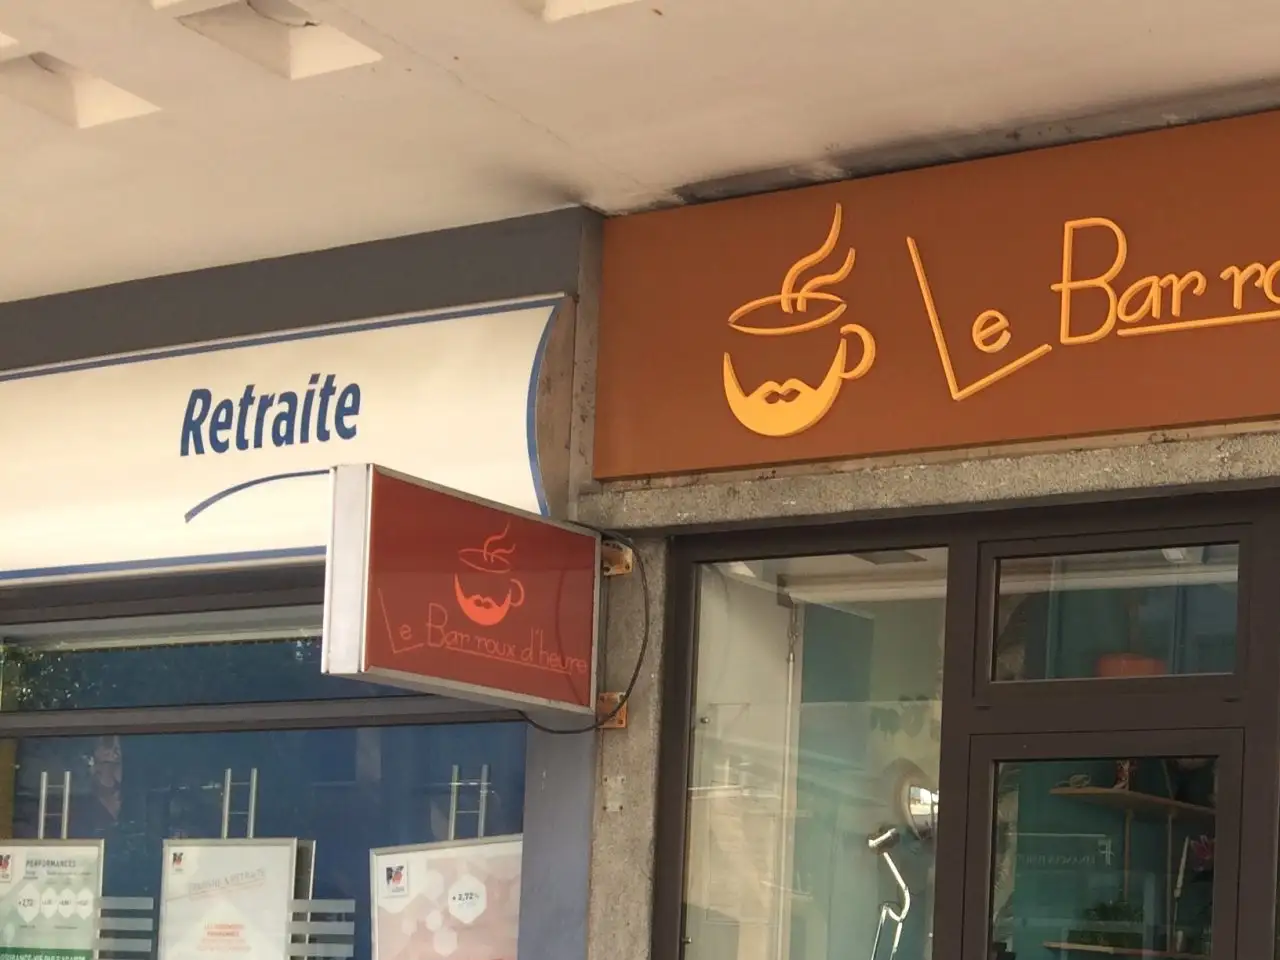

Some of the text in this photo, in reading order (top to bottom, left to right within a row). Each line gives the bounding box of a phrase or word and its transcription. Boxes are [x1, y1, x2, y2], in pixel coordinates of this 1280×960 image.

[908, 236, 1052, 401] Le
[1052, 216, 1208, 345] Bar
[180, 373, 361, 457] Retraite
[378, 588, 588, 673] Le Bar roux d'heure
